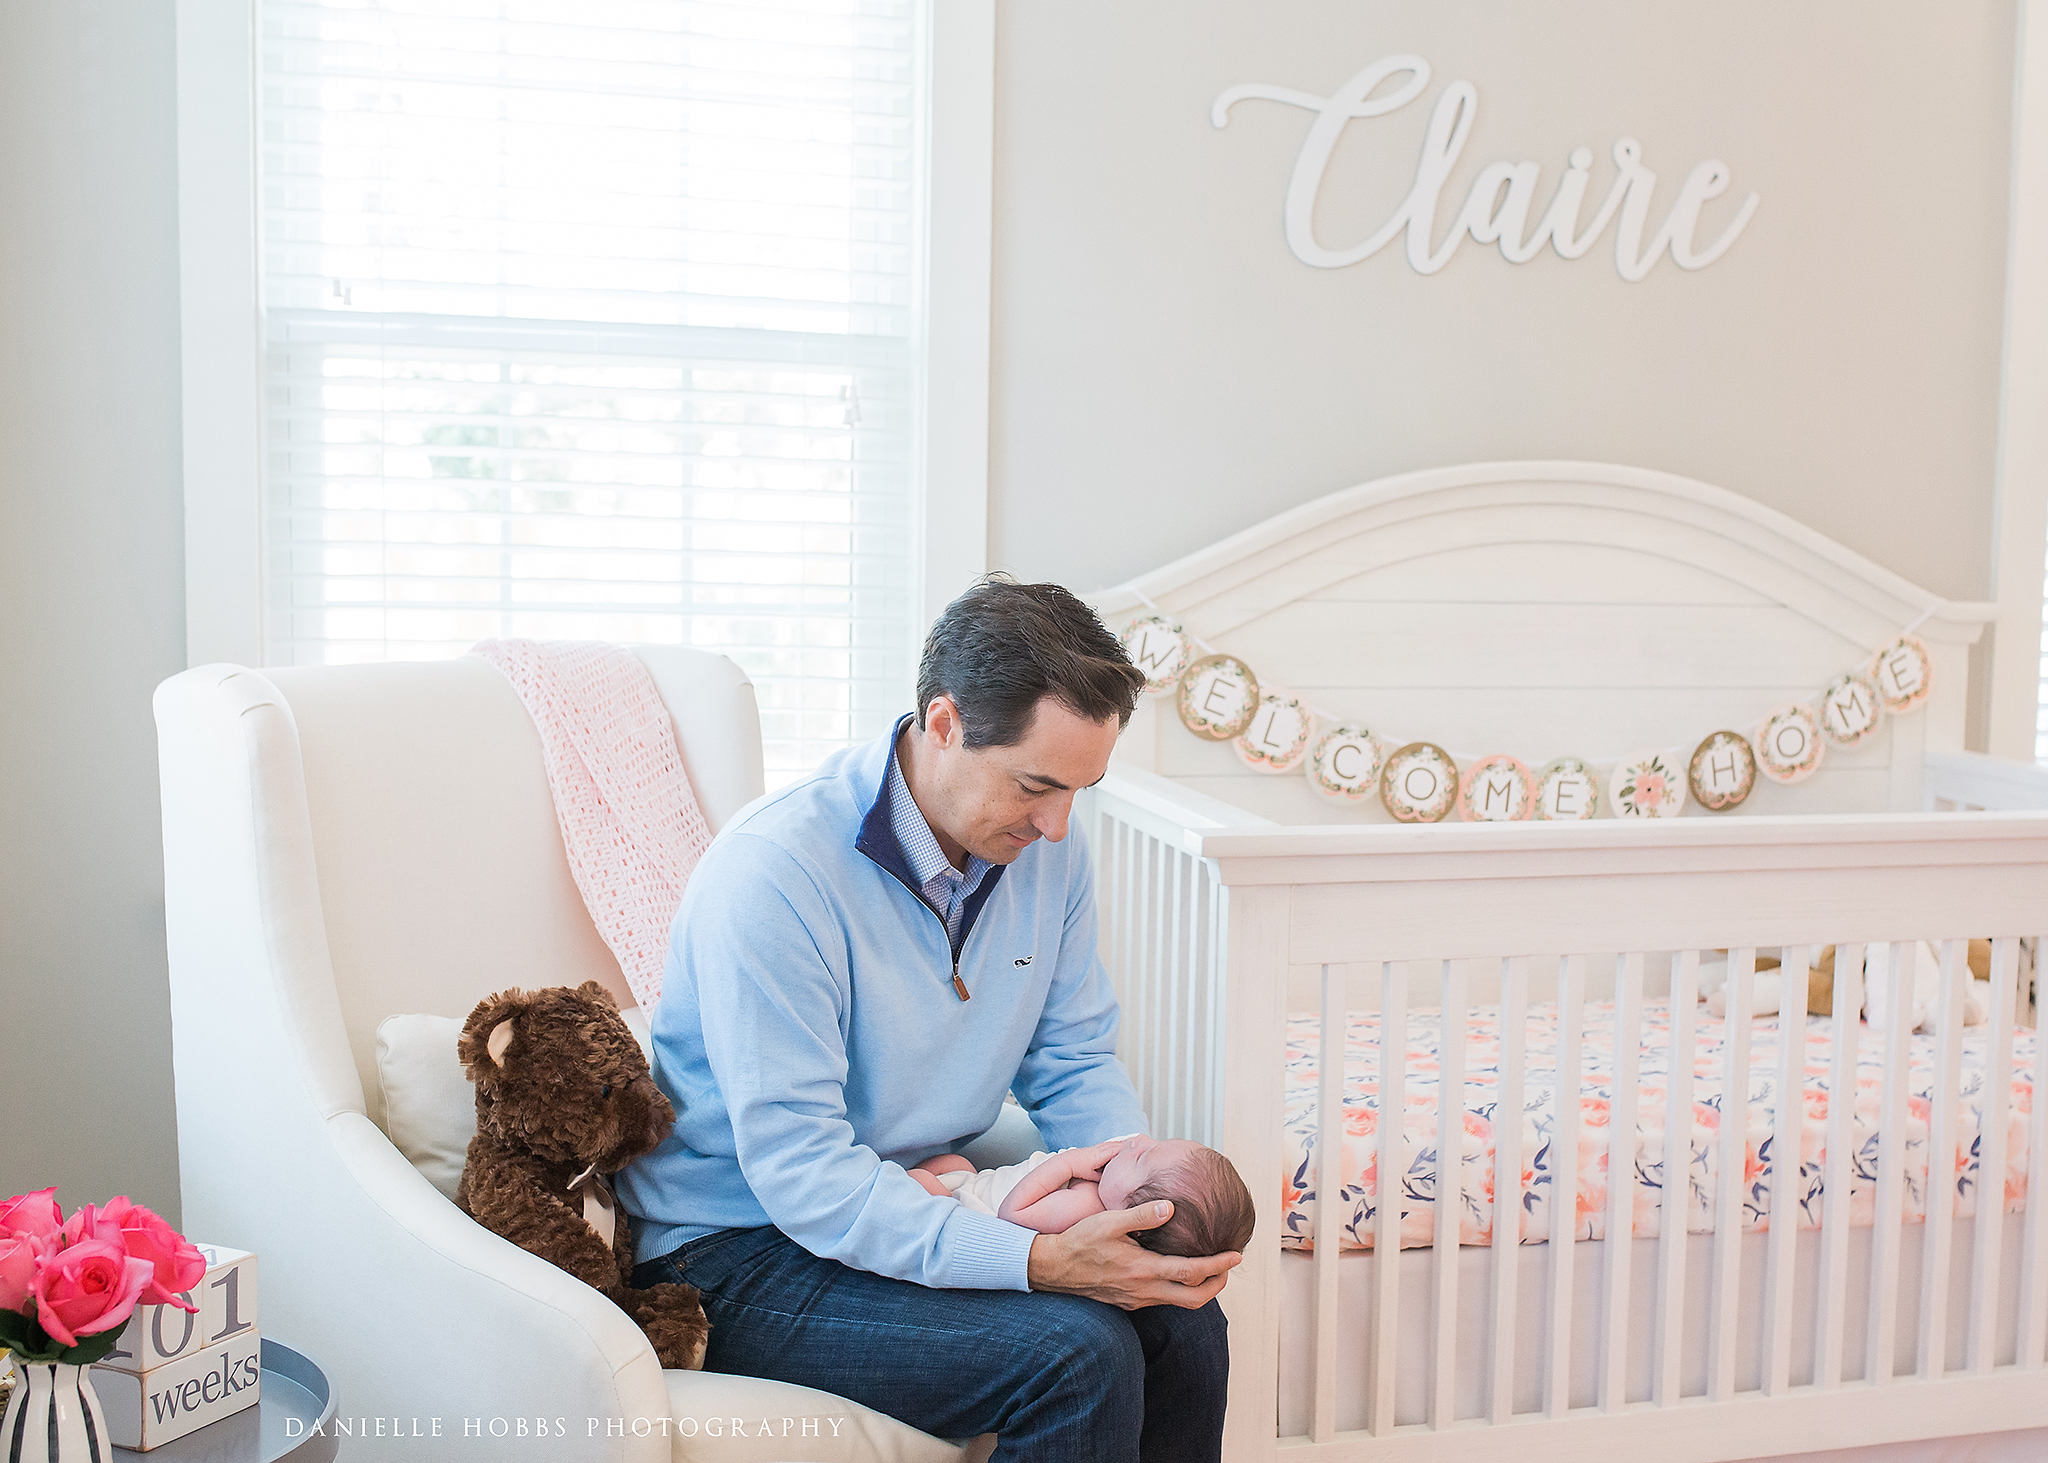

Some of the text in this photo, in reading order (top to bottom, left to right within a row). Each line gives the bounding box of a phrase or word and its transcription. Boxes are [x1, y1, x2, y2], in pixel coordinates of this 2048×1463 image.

[1210, 53, 1760, 283] Claire
[1139, 631, 1917, 815] WELCOME HOME
[150, 1351, 259, 1425] weeks
